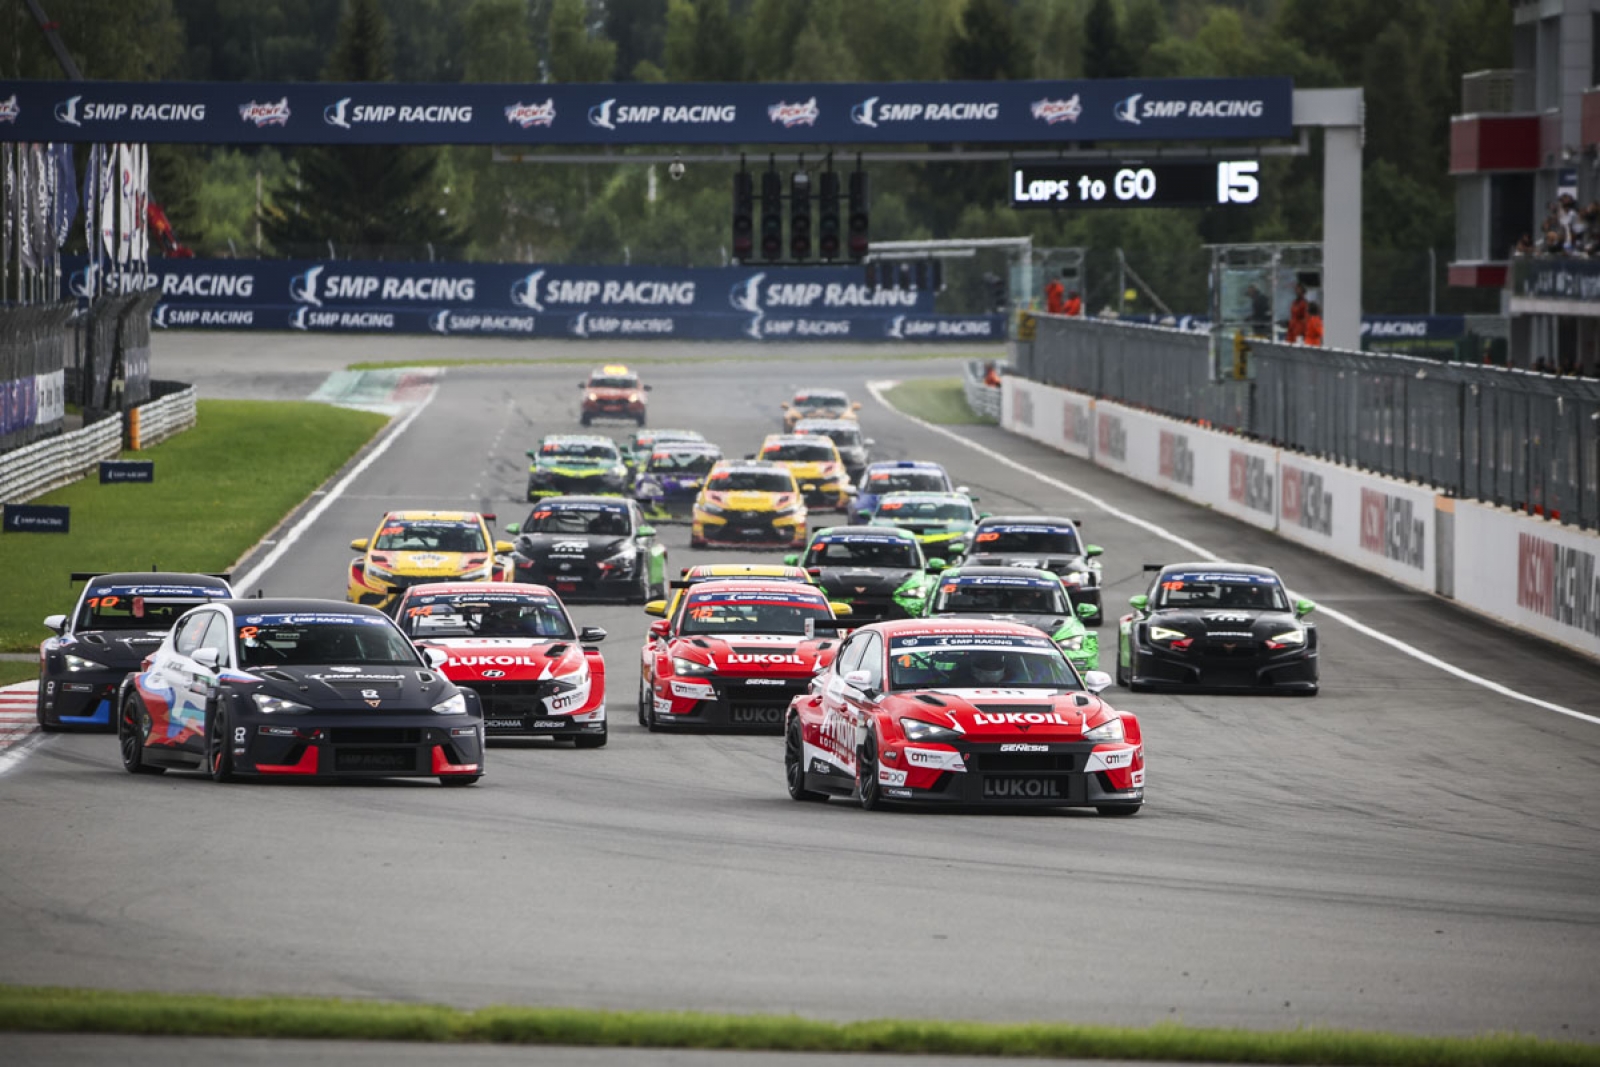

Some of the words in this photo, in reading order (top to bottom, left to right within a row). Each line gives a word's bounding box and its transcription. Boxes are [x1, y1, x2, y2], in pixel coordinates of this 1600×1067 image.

[83, 103, 128, 121] SMP
[130, 103, 206, 121] RACING
[351, 105, 397, 122] SMP
[398, 106, 473, 123] RACING
[616, 105, 661, 122] SMP
[661, 105, 736, 123] RACING
[877, 103, 923, 121] SMP
[924, 102, 999, 121] RACING
[1142, 101, 1187, 118] SMP
[1187, 100, 1263, 117] RACING
[1014, 170, 1070, 201] Laps
[1079, 174, 1107, 200] to
[1114, 168, 1157, 200] GO
[1217, 161, 1260, 204] 15
[106, 274, 158, 296] SMP
[161, 275, 255, 297] RACING
[324, 276, 381, 298] SMP
[381, 277, 476, 300] RACING
[544, 280, 600, 304] SMP
[601, 281, 696, 305] RACING
[765, 284, 821, 306] SMP
[822, 284, 918, 307] RACING
[168, 312, 200, 325] SMP
[200, 312, 254, 325] RACING
[308, 312, 341, 327] SMP
[341, 313, 394, 328] RACING
[448, 316, 481, 330] SMP
[481, 317, 535, 332] RACING
[1371, 322, 1427, 336] RACING
[87, 596, 120, 608] 10
[406, 605, 433, 618] 14
[974, 638, 1013, 646] RACING
[448, 655, 536, 667] LUKOIL
[727, 653, 805, 665] LUKOIL
[898, 655, 911, 668] 1
[744, 678, 787, 686] GENESIS
[484, 719, 522, 728] OKOHAMA
[533, 720, 566, 728] GENESIS
[972, 712, 1069, 726] LUKOIL
[1000, 743, 1049, 752] GENESIS
[984, 779, 1060, 797] LUKOIL
